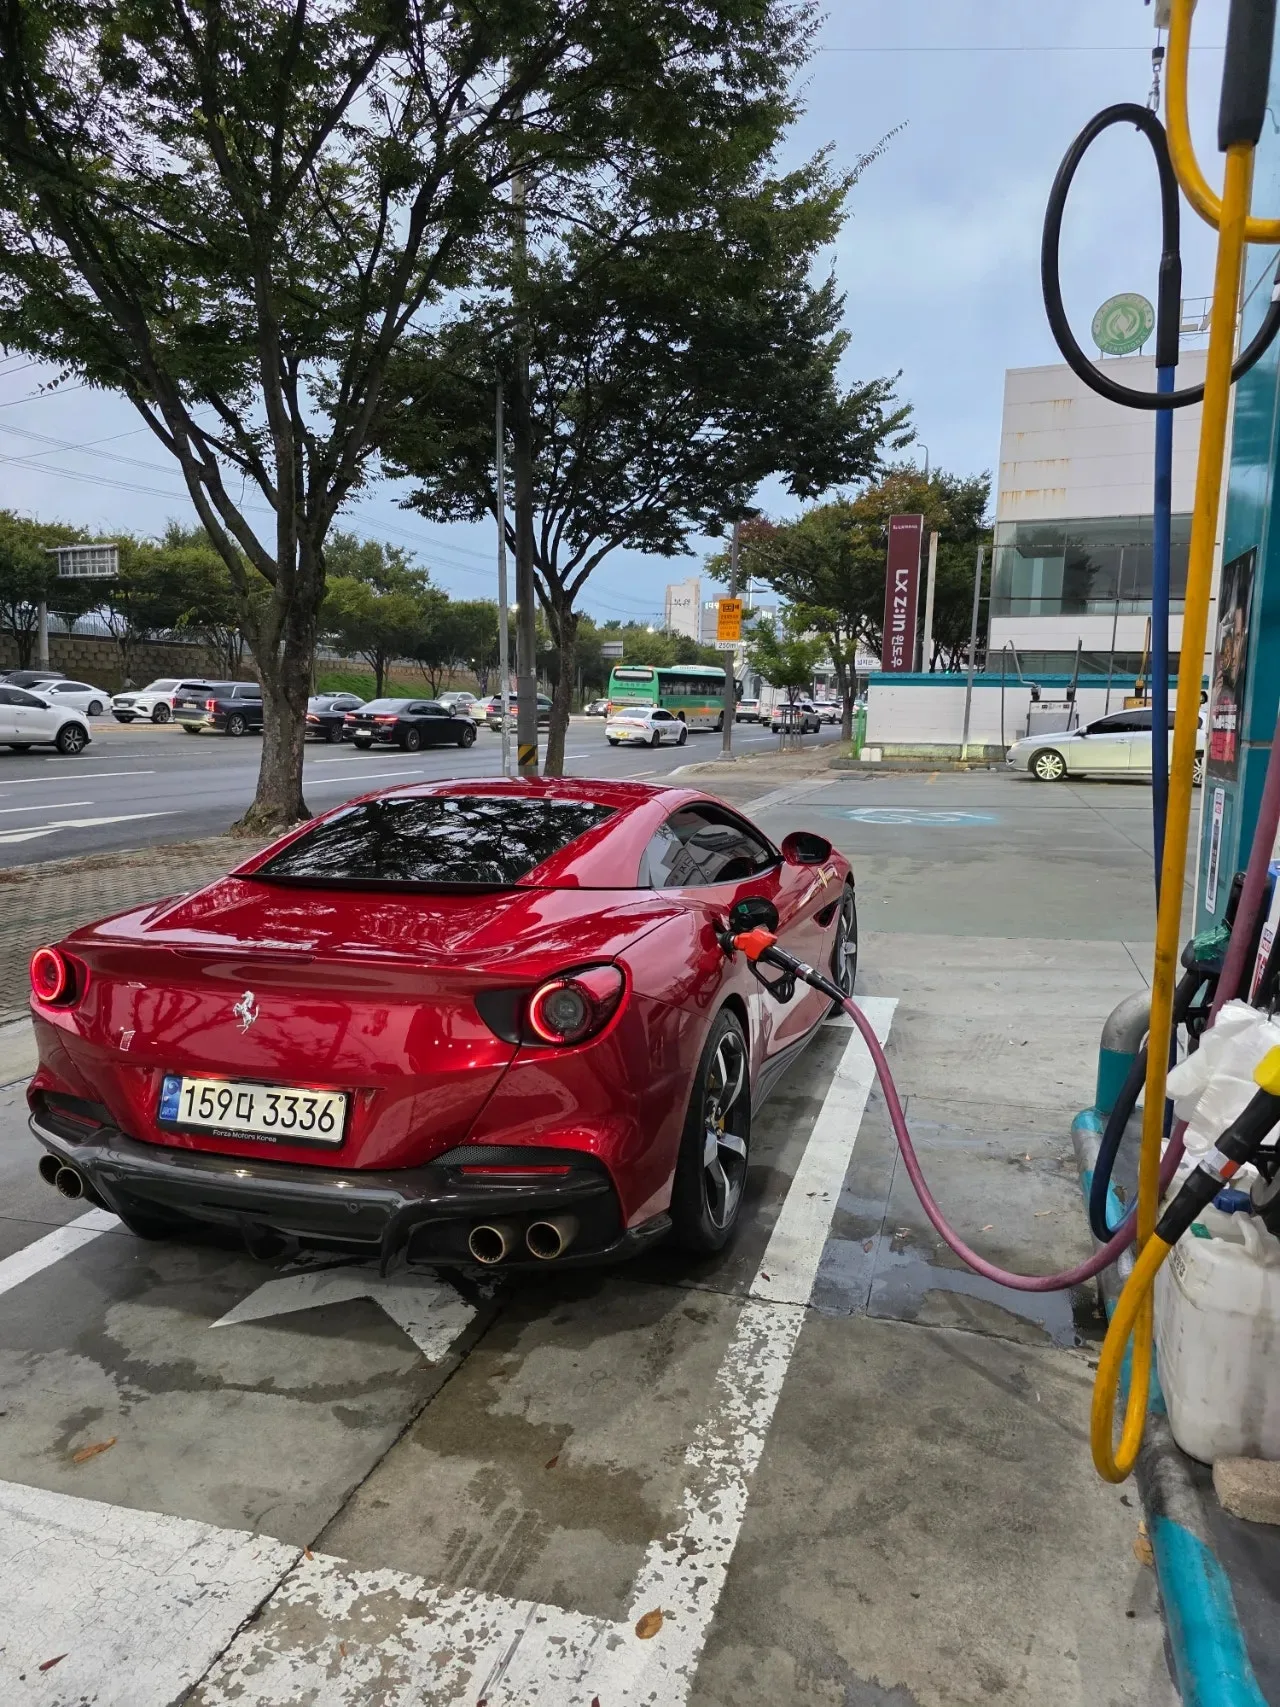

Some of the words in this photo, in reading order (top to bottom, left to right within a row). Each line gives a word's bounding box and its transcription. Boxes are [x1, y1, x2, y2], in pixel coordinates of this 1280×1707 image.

[895, 569, 908, 592] LX
[891, 635, 904, 667] 윈도우
[185, 1085, 254, 1122] 159다
[262, 1093, 335, 1132] 3336
[212, 1129, 231, 1137] Forza
[232, 1132, 256, 1140] Motors
[256, 1135, 277, 1143] Korea
